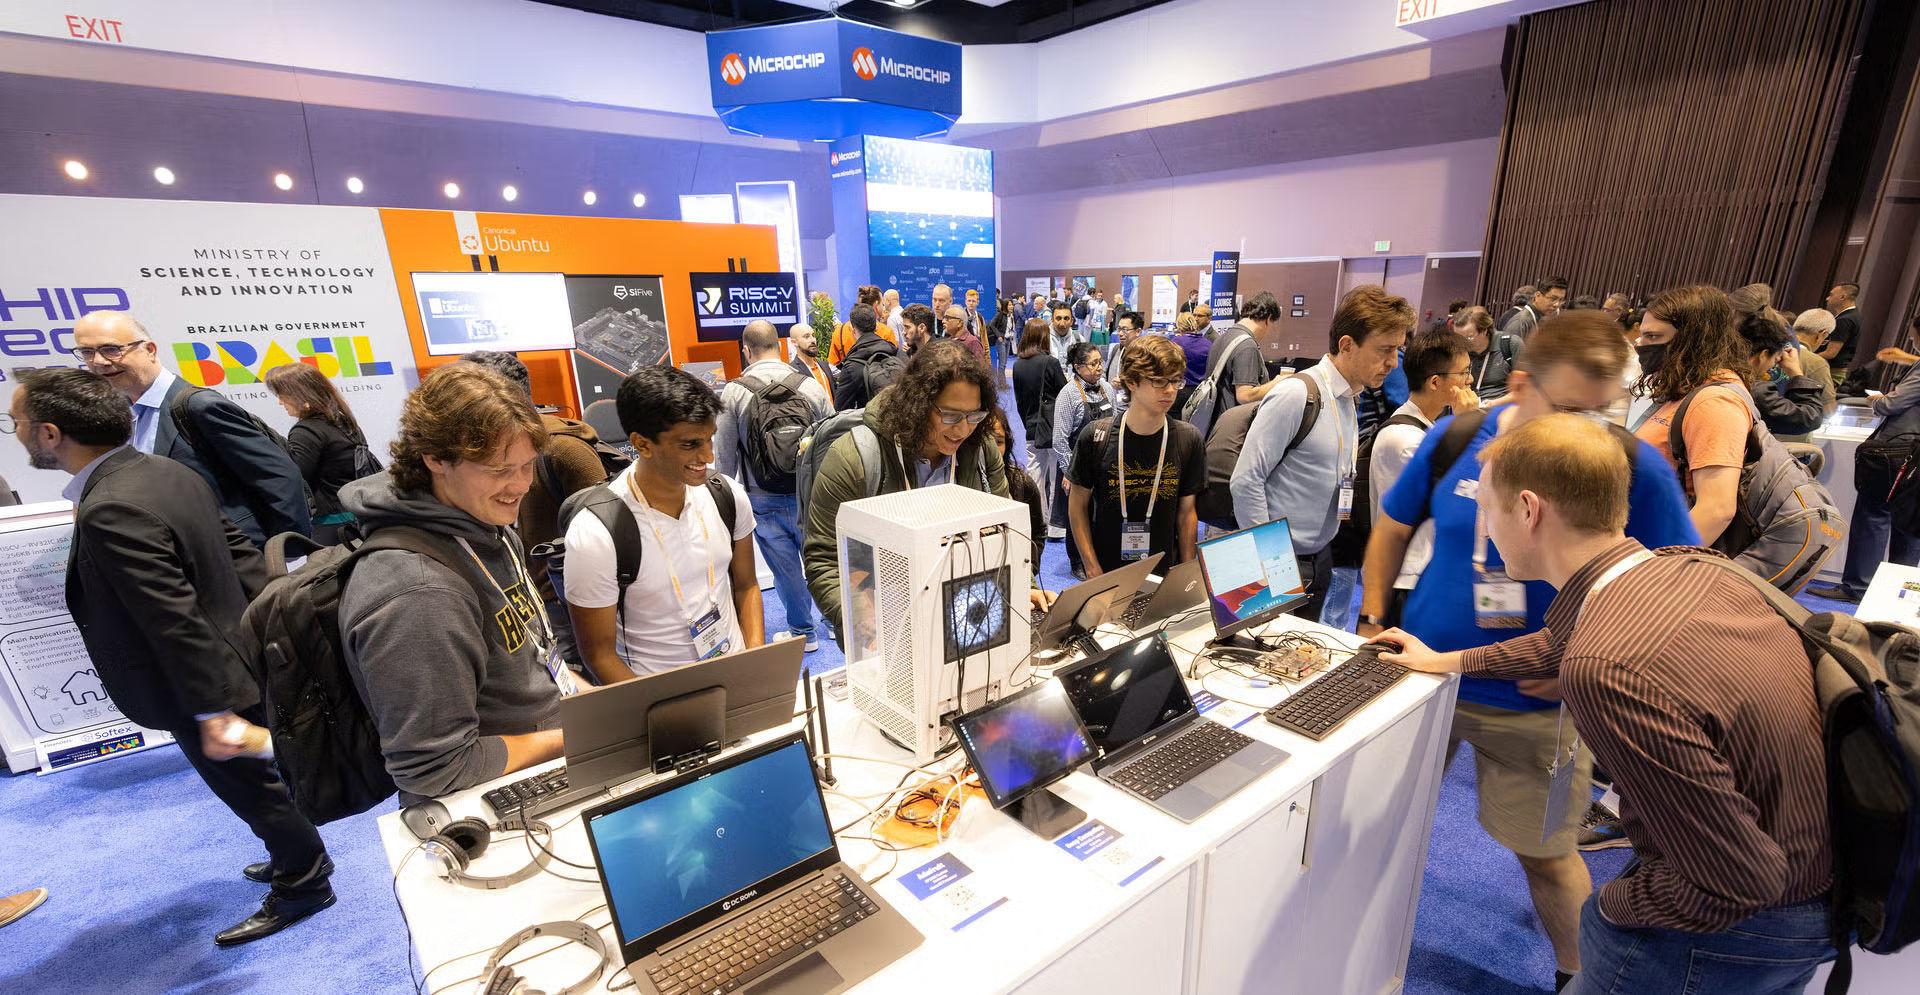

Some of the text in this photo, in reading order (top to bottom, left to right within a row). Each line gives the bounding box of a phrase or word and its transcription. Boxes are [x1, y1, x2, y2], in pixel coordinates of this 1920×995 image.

[65, 14, 122, 43] EXIT
[484, 234, 550, 252] Ubuntu
[193, 248, 322, 260] MINISTRY OF
[140, 267, 375, 279] SCIENCE, TECHNOLOGY
[181, 284, 354, 296] AND INNOVATION
[629, 288, 653, 297] SiFive
[728, 287, 794, 300] RISC-V
[730, 301, 792, 315] SUMMIT
[187, 320, 367, 335] BRAZILIAN GOVERNMENT
[4, 602, 43, 612] Bluetooth
[6, 637, 27, 645] Main
[29, 629, 72, 641] Application
[16, 643, 39, 651] Smart
[40, 638, 62, 647] home
[23, 655, 46, 664] Smart
[95, 726, 133, 740] Softex
[730, 889, 758, 907] DC ROMA
